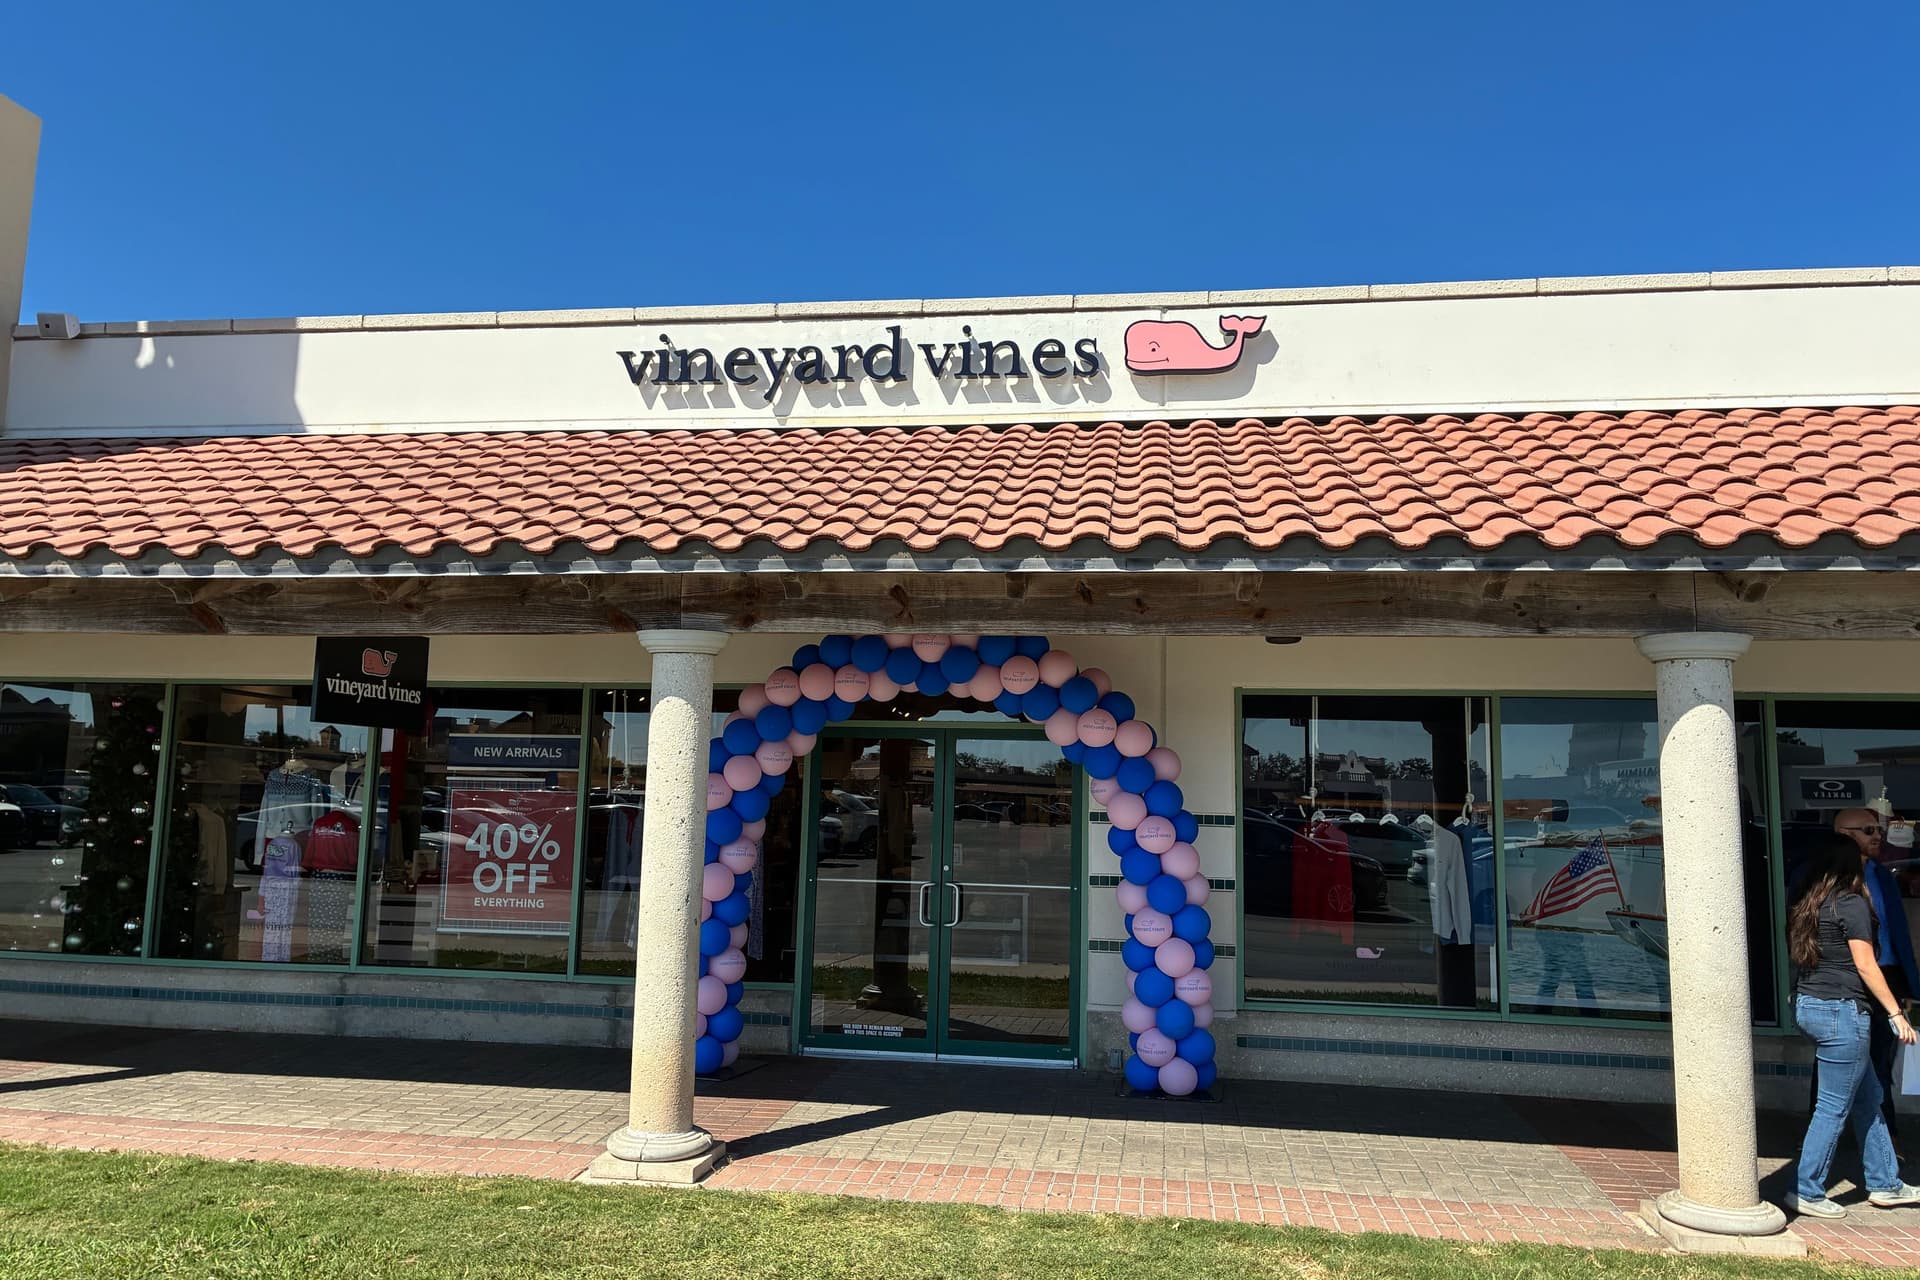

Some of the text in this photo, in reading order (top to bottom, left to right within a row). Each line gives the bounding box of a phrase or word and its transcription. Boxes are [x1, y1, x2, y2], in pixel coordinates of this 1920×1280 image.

[617, 325, 1101, 401] vineyard vines
[326, 673, 421, 704] vineyard vines
[474, 747, 562, 759] NEW ARRIVALS
[465, 822, 561, 861] 40%
[472, 861, 550, 894] OFF
[473, 897, 545, 909] EVERYTHING
